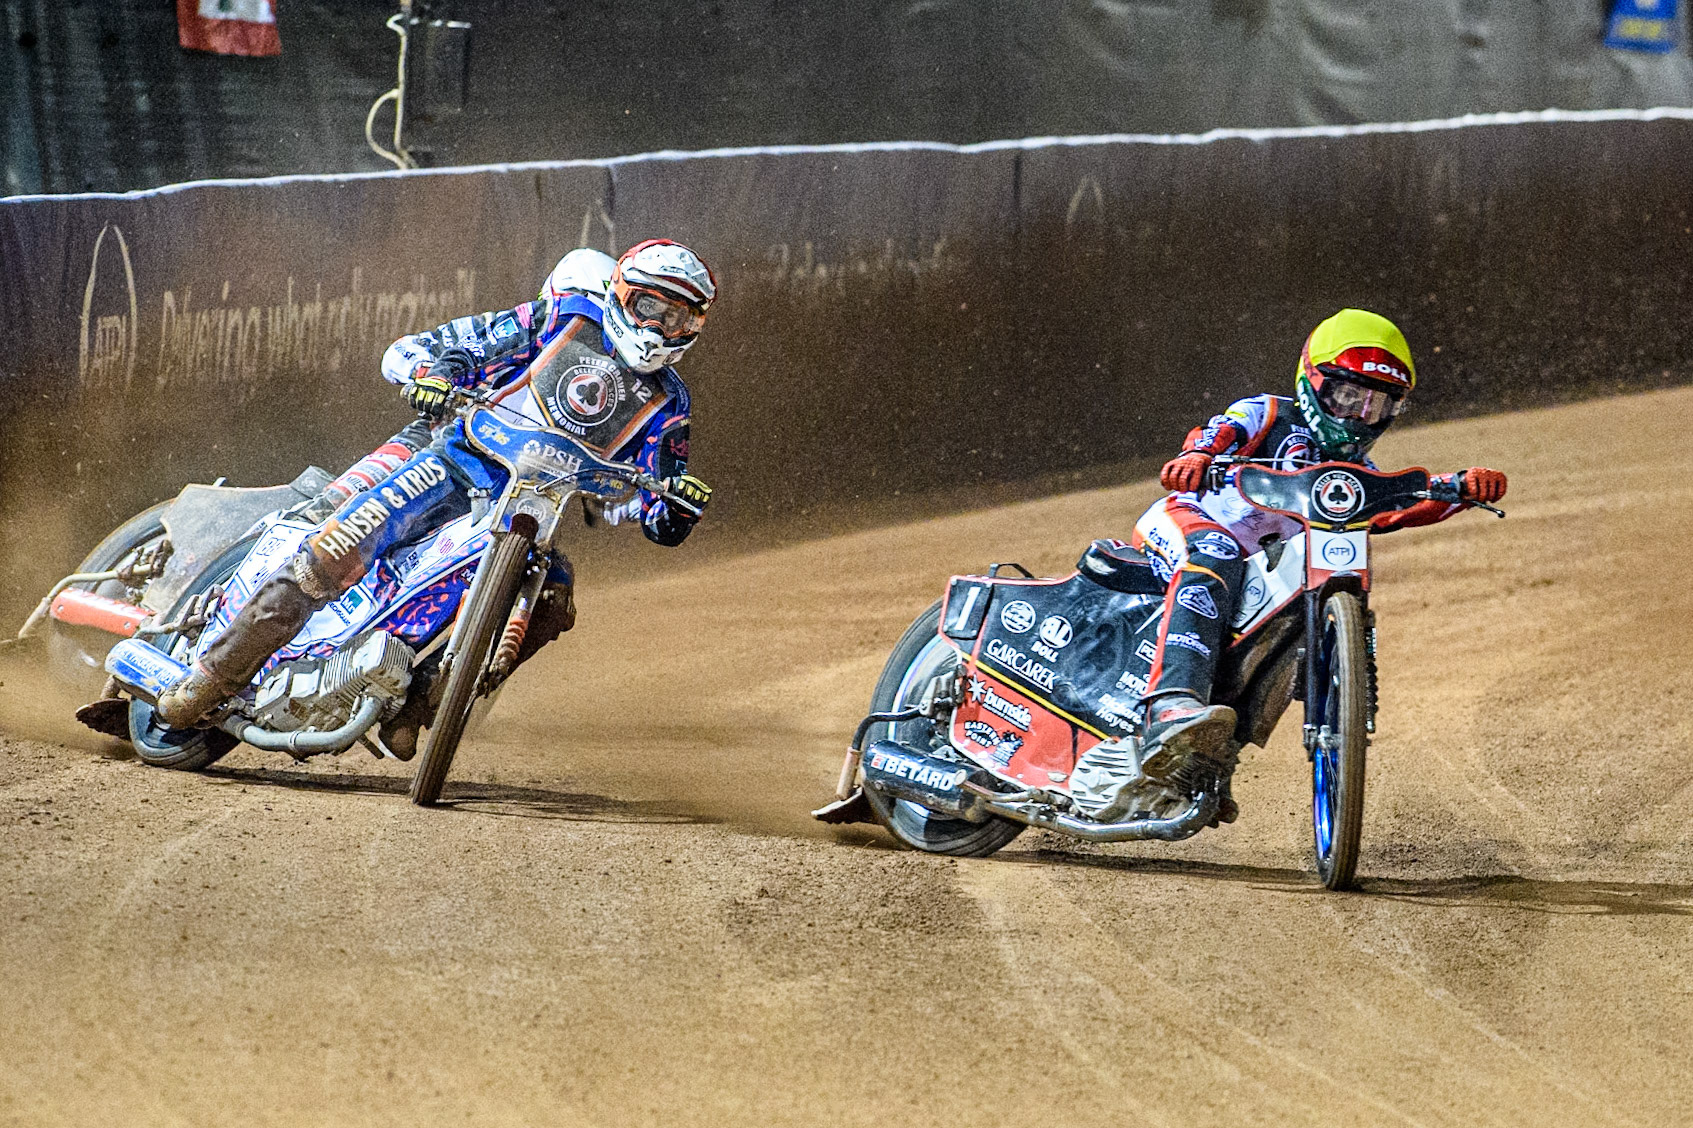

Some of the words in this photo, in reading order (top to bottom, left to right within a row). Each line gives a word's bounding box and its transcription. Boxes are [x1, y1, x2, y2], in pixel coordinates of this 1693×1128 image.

[573, 367, 598, 376] BELLE
[579, 356, 608, 367] PETER
[608, 364, 626, 402] CRAVEN
[1362, 361, 1408, 383] BOLL
[631, 378, 653, 404] 12
[546, 396, 587, 436] MEMORIAL
[541, 443, 583, 474] PSH
[318, 497, 391, 560] HANSEN
[380, 486, 408, 509] &
[394, 456, 447, 501] KRUS
[1328, 546, 1351, 557] ATPI
[955, 586, 981, 631] 1
[987, 638, 1060, 690] GARCAREK
[1031, 640, 1059, 663] BOLL
[983, 686, 1032, 727] burnside
[1095, 706, 1135, 733] Hayes
[964, 721, 1001, 746] EASTERN
[965, 730, 993, 748] POINT
[884, 757, 956, 791] BETARD
